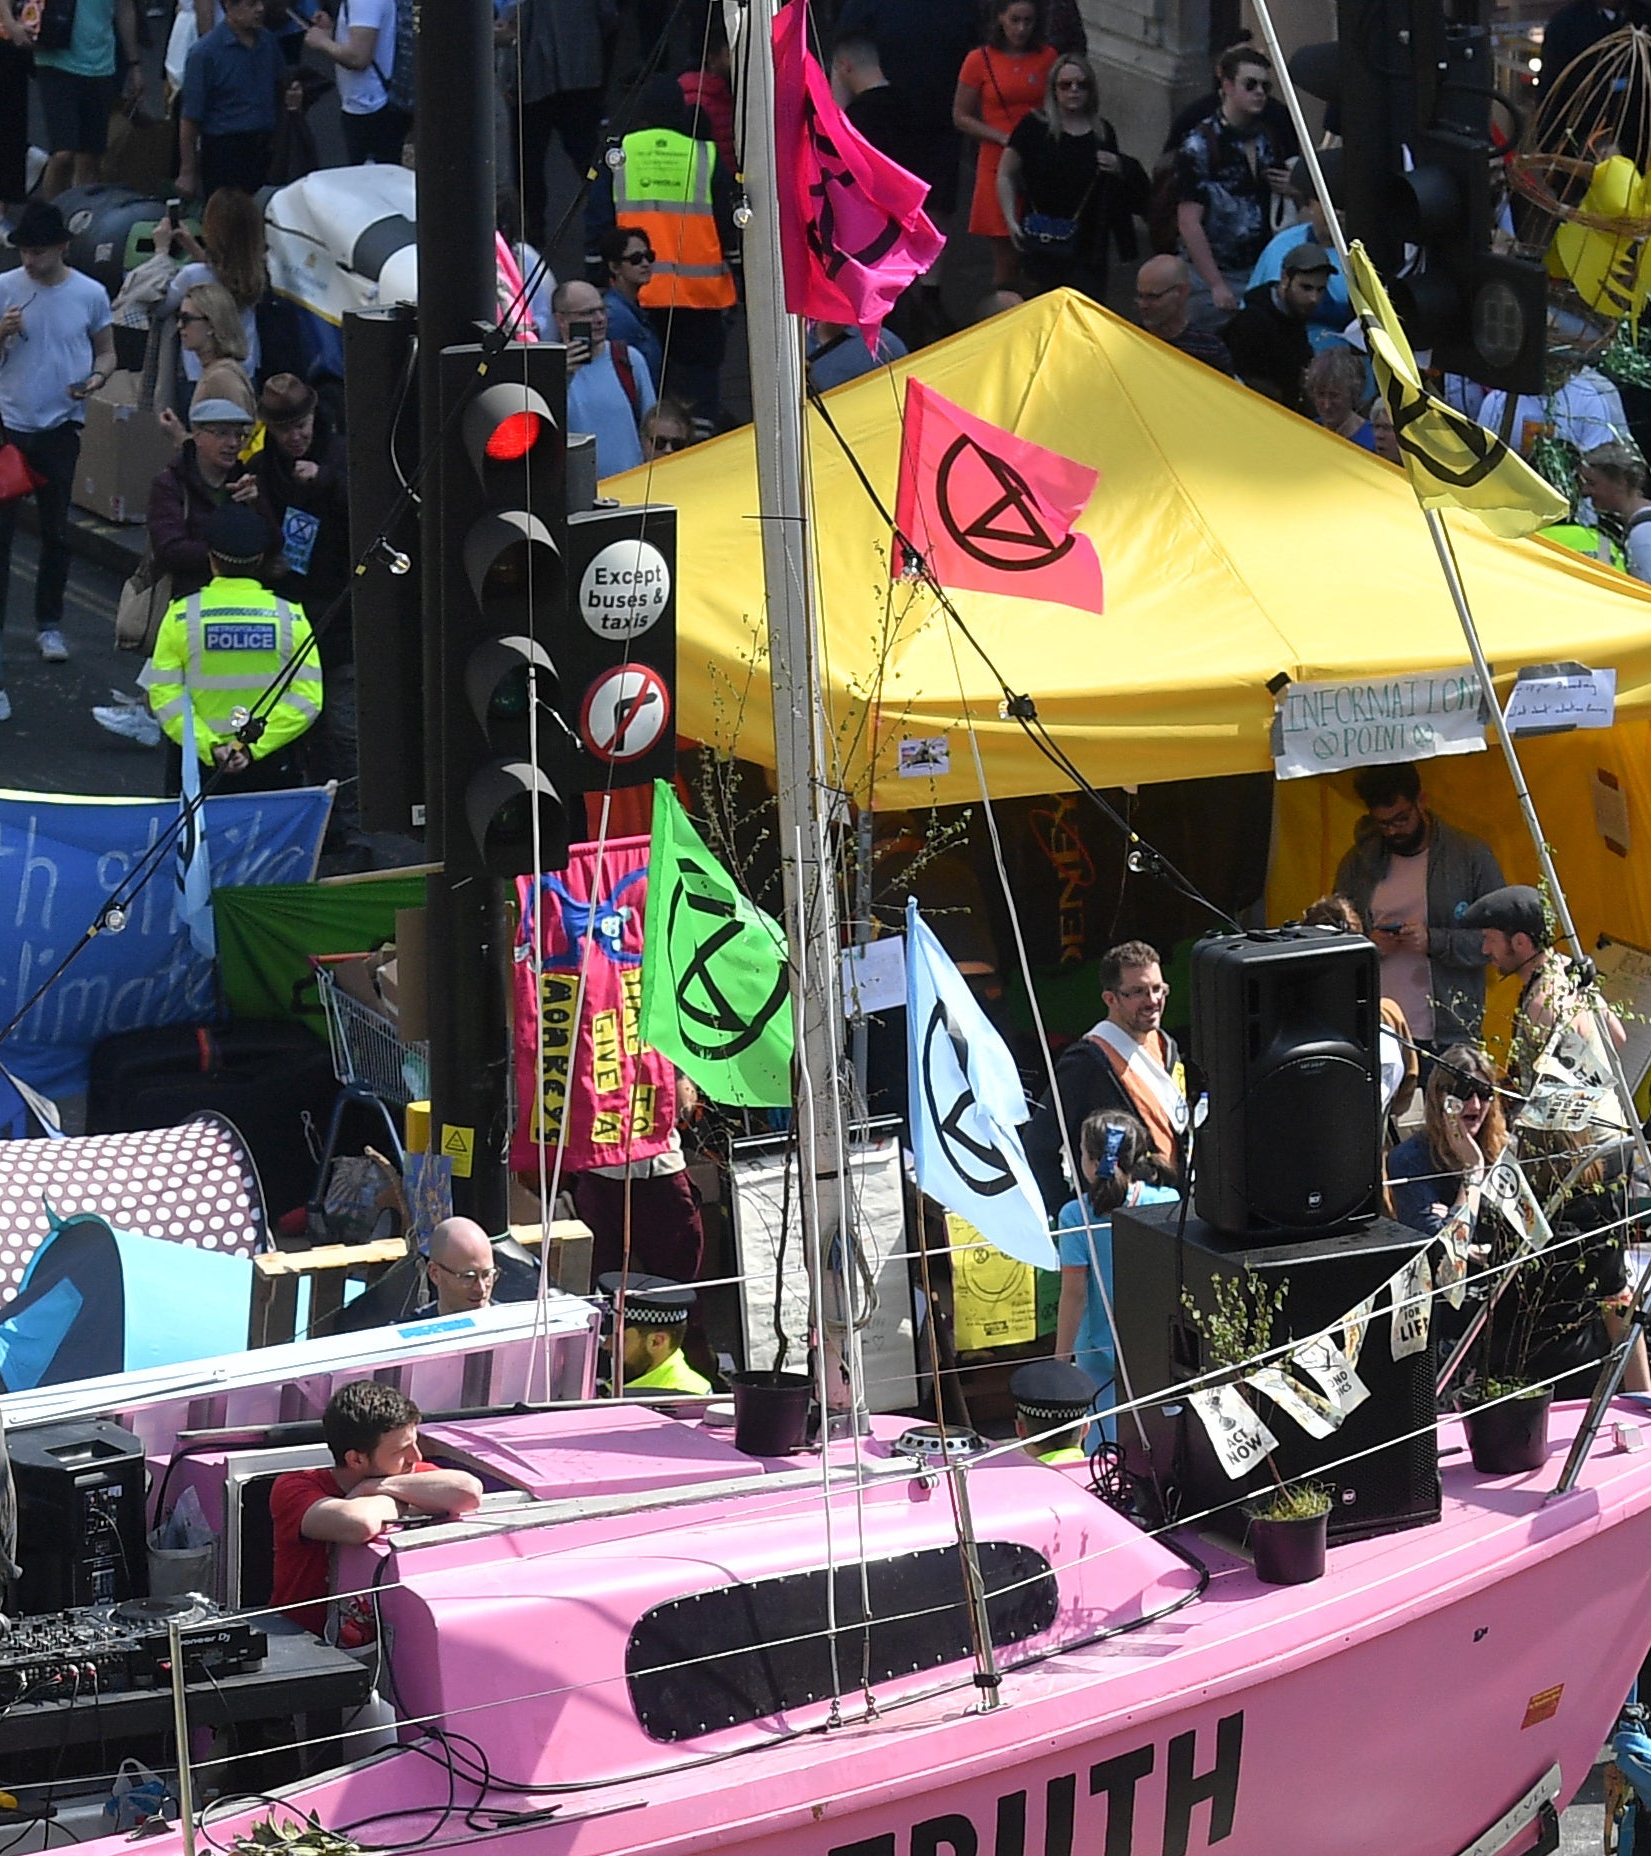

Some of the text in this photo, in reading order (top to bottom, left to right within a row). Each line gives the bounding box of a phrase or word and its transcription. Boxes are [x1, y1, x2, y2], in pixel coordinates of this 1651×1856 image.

[595, 565, 662, 588] Except
[588, 587, 663, 609] buses &
[206, 624, 275, 634] METROPOLITAN
[600, 613, 650, 631] taxis
[206, 632, 276, 650] POLICE
[1285, 674, 1477, 733] INFORMATION
[1345, 724, 1405, 758] POINT
[594, 1013, 620, 1137] GIVE A
[1225, 1434, 1263, 1466] NOW
[1227, 1427, 1249, 1450] ACT
[180, 1635, 216, 1647] oneer
